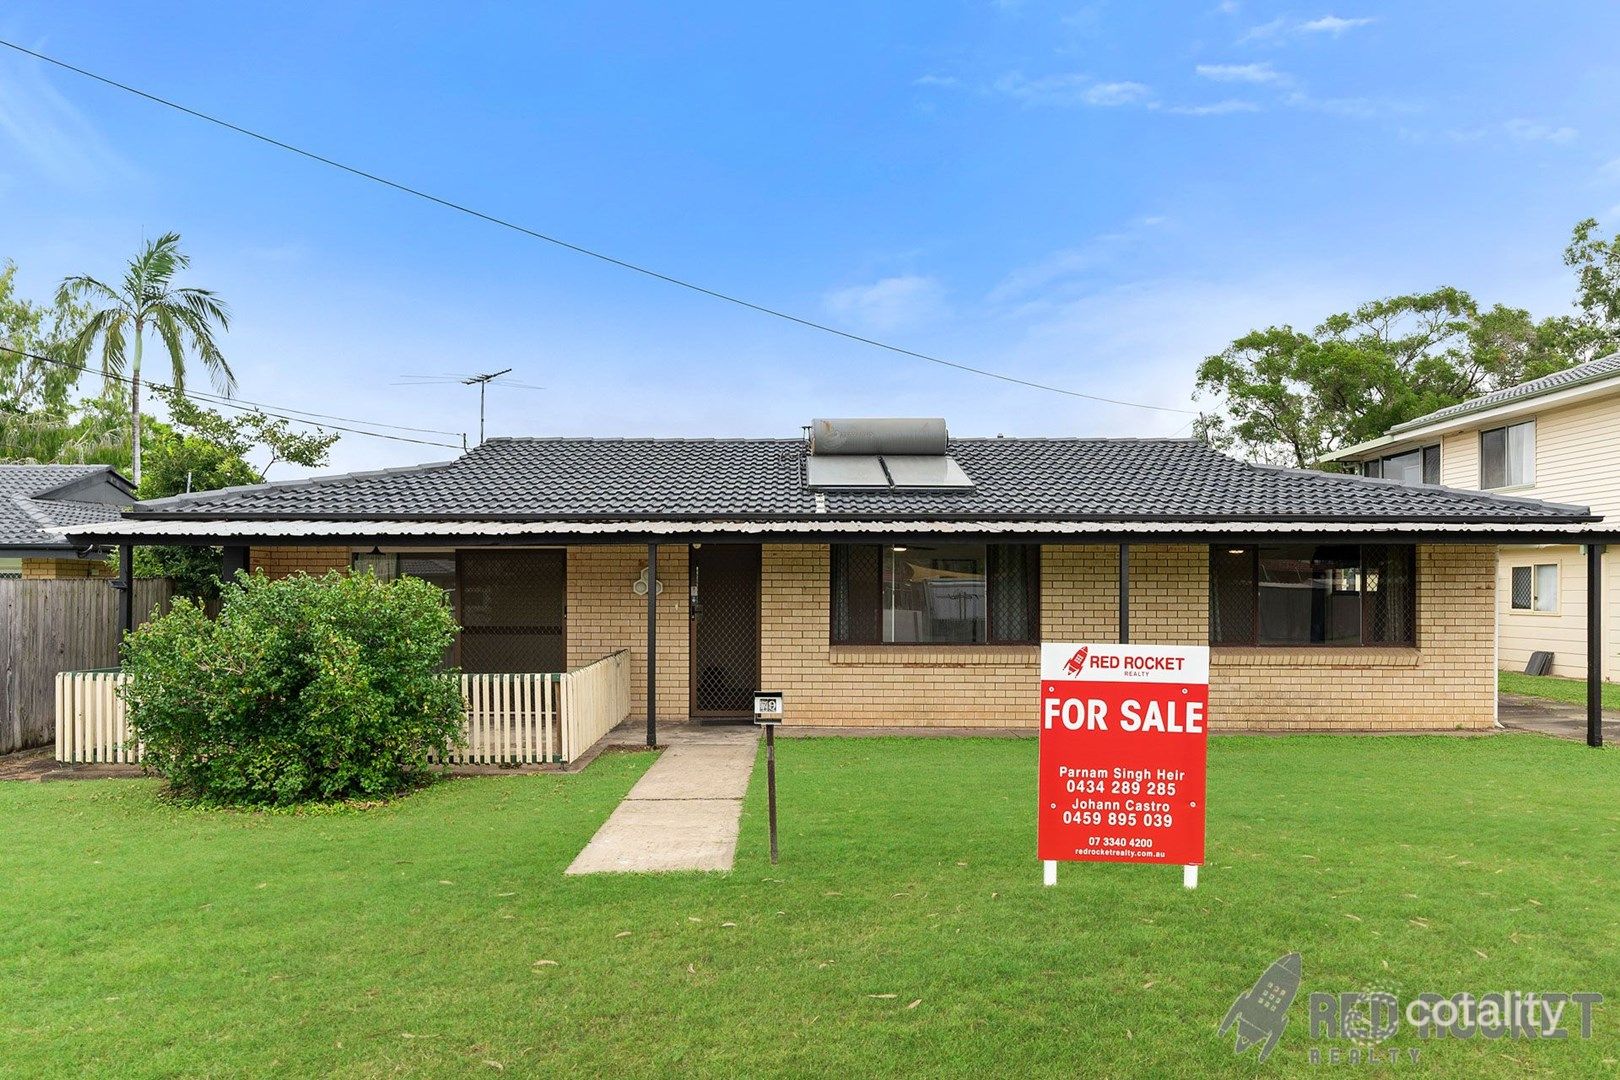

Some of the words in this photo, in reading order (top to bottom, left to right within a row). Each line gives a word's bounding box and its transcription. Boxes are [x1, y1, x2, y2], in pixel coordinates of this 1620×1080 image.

[1090, 656, 1120, 669] RED
[1124, 657, 1185, 671] ROCKET
[1044, 698, 1108, 731] FOR
[1120, 699, 1203, 733] SALE
[1059, 766, 1108, 778] Parnam
[1113, 767, 1151, 783] Singh
[1157, 769, 1185, 780] Heir
[1066, 780, 1105, 793] 0434
[1111, 781, 1141, 794] 289
[1147, 782, 1176, 796] 285
[1072, 798, 1120, 810] Johann
[1125, 800, 1170, 812] Castro
[1063, 811, 1102, 824] 0459
[1108, 812, 1137, 826] 895
[1143, 814, 1173, 827] 039
[1088, 837, 1101, 846] 07
[1103, 838, 1126, 847] 3340
[1128, 838, 1153, 848] 4200
[1075, 848, 1166, 858] redrocketrealty.com.au
